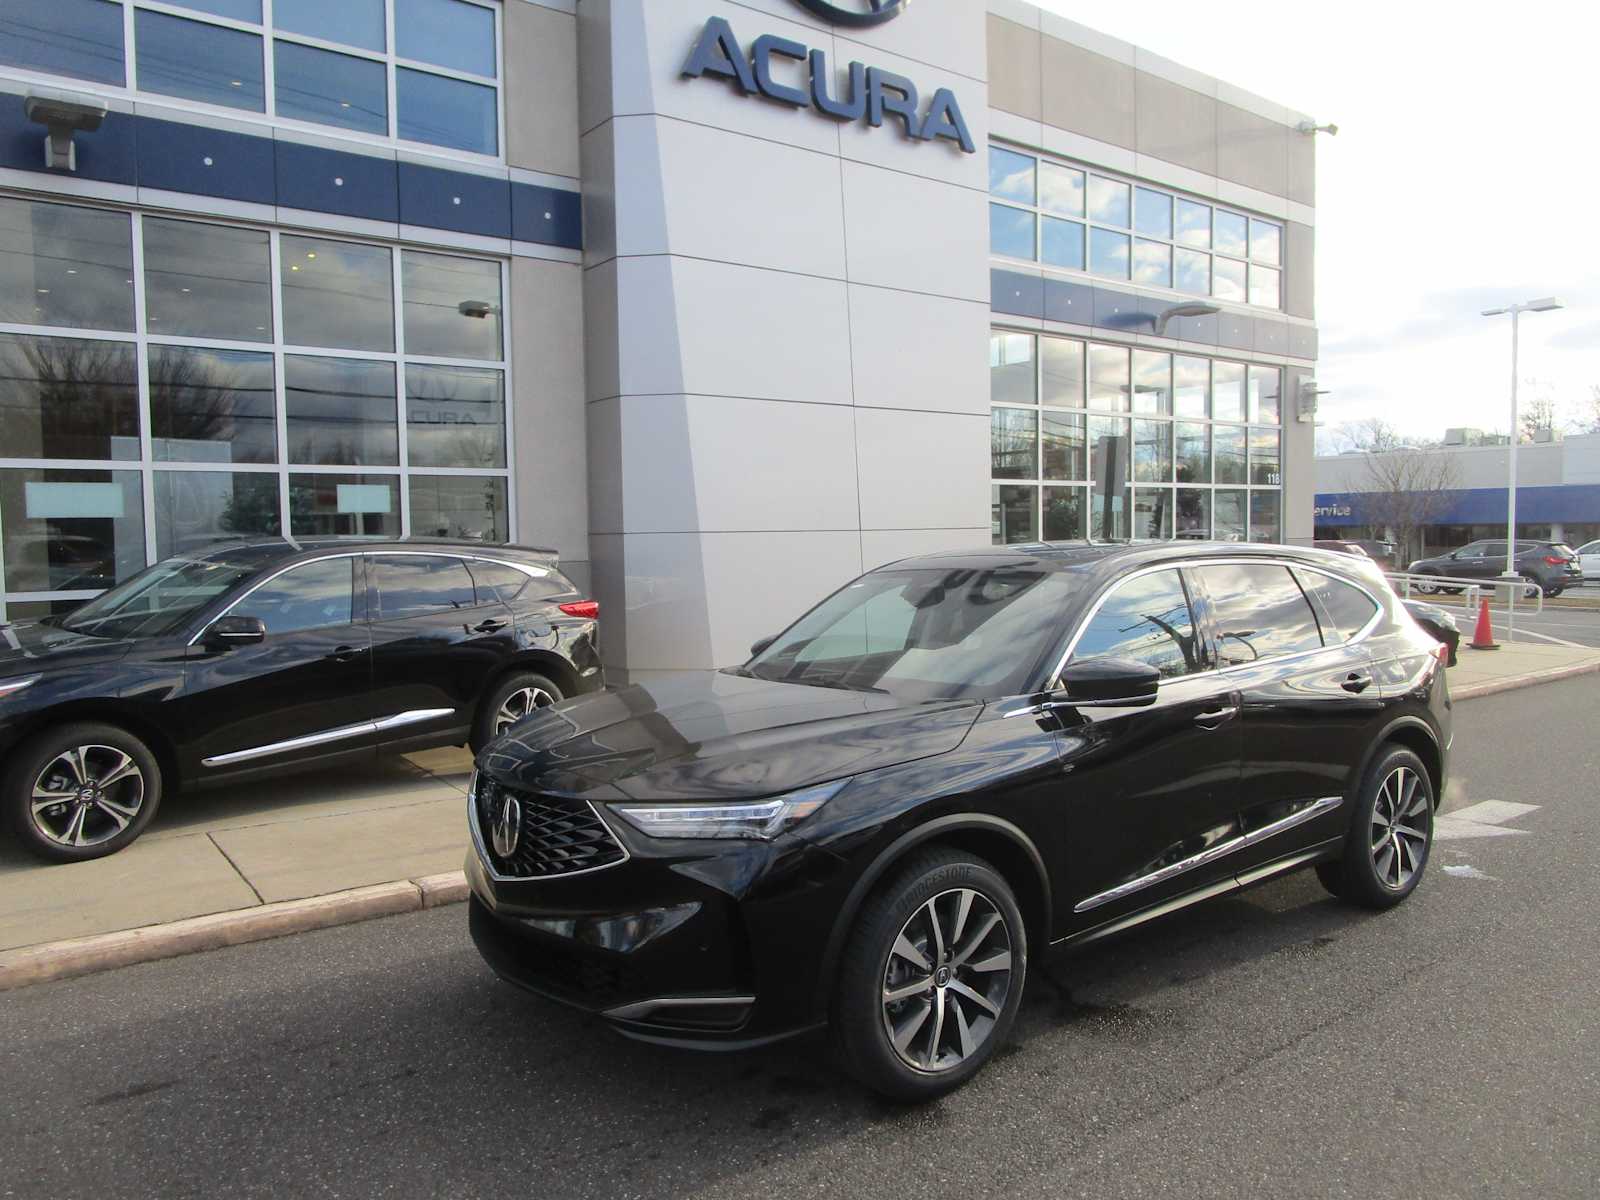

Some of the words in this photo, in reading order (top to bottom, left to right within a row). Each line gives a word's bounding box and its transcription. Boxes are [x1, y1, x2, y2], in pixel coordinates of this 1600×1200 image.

[681, 15, 975, 153] ACURA
[407, 410, 475, 424] CURA
[1314, 503, 1351, 516] ervice
